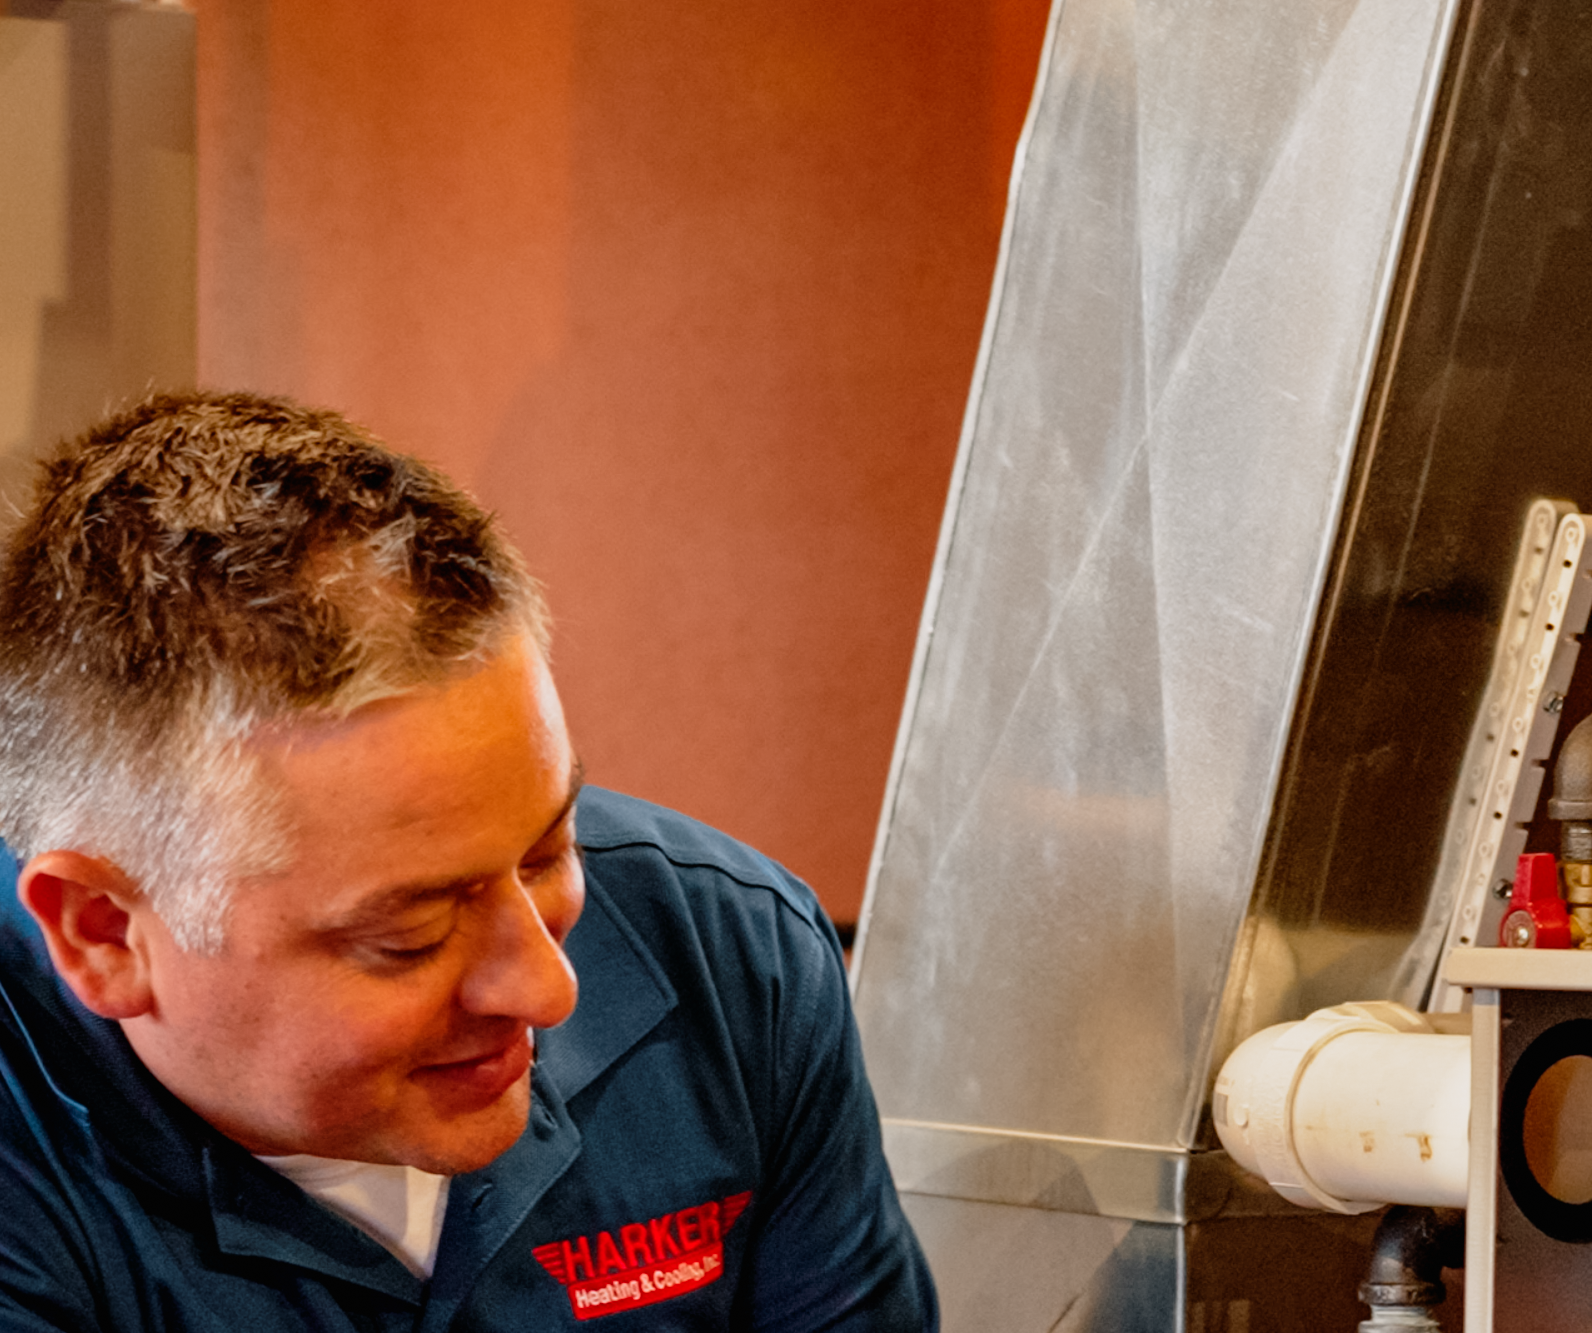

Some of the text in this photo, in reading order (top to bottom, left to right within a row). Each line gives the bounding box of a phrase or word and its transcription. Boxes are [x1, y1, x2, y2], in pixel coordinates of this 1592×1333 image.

[562, 1200, 723, 1284] HARKER
[575, 1279, 641, 1309] Heating
[639, 1272, 656, 1294] &
[653, 1261, 705, 1290] Cooling,
